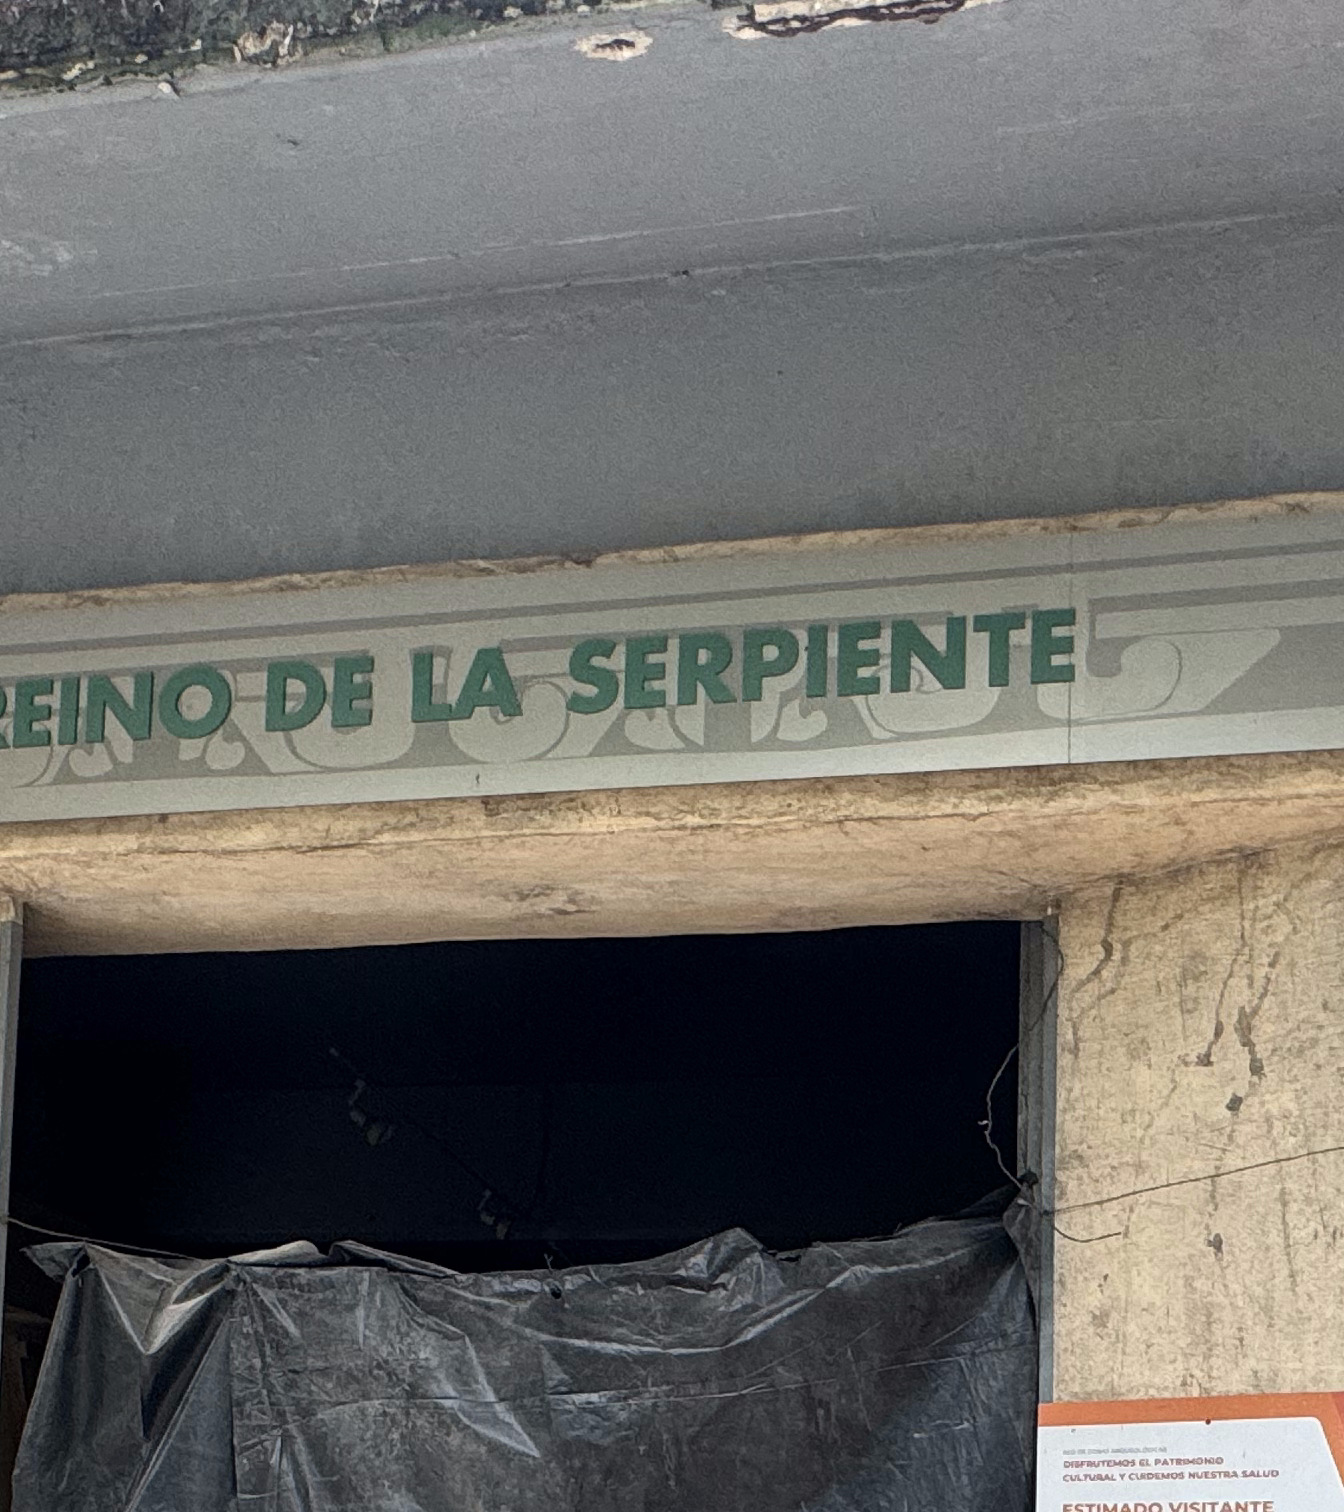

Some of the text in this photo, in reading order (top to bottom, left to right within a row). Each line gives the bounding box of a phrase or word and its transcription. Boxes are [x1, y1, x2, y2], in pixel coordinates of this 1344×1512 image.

[265, 658, 372, 730] DE
[412, 647, 518, 721] LA
[569, 609, 1074, 713] SERPIENTE
[1139, 1459, 1150, 1467] EL
[1063, 1474, 1116, 1482] CULTURAL
[1188, 1470, 1238, 1479] NUESTRA
[1241, 1469, 1279, 1478] SALUD
